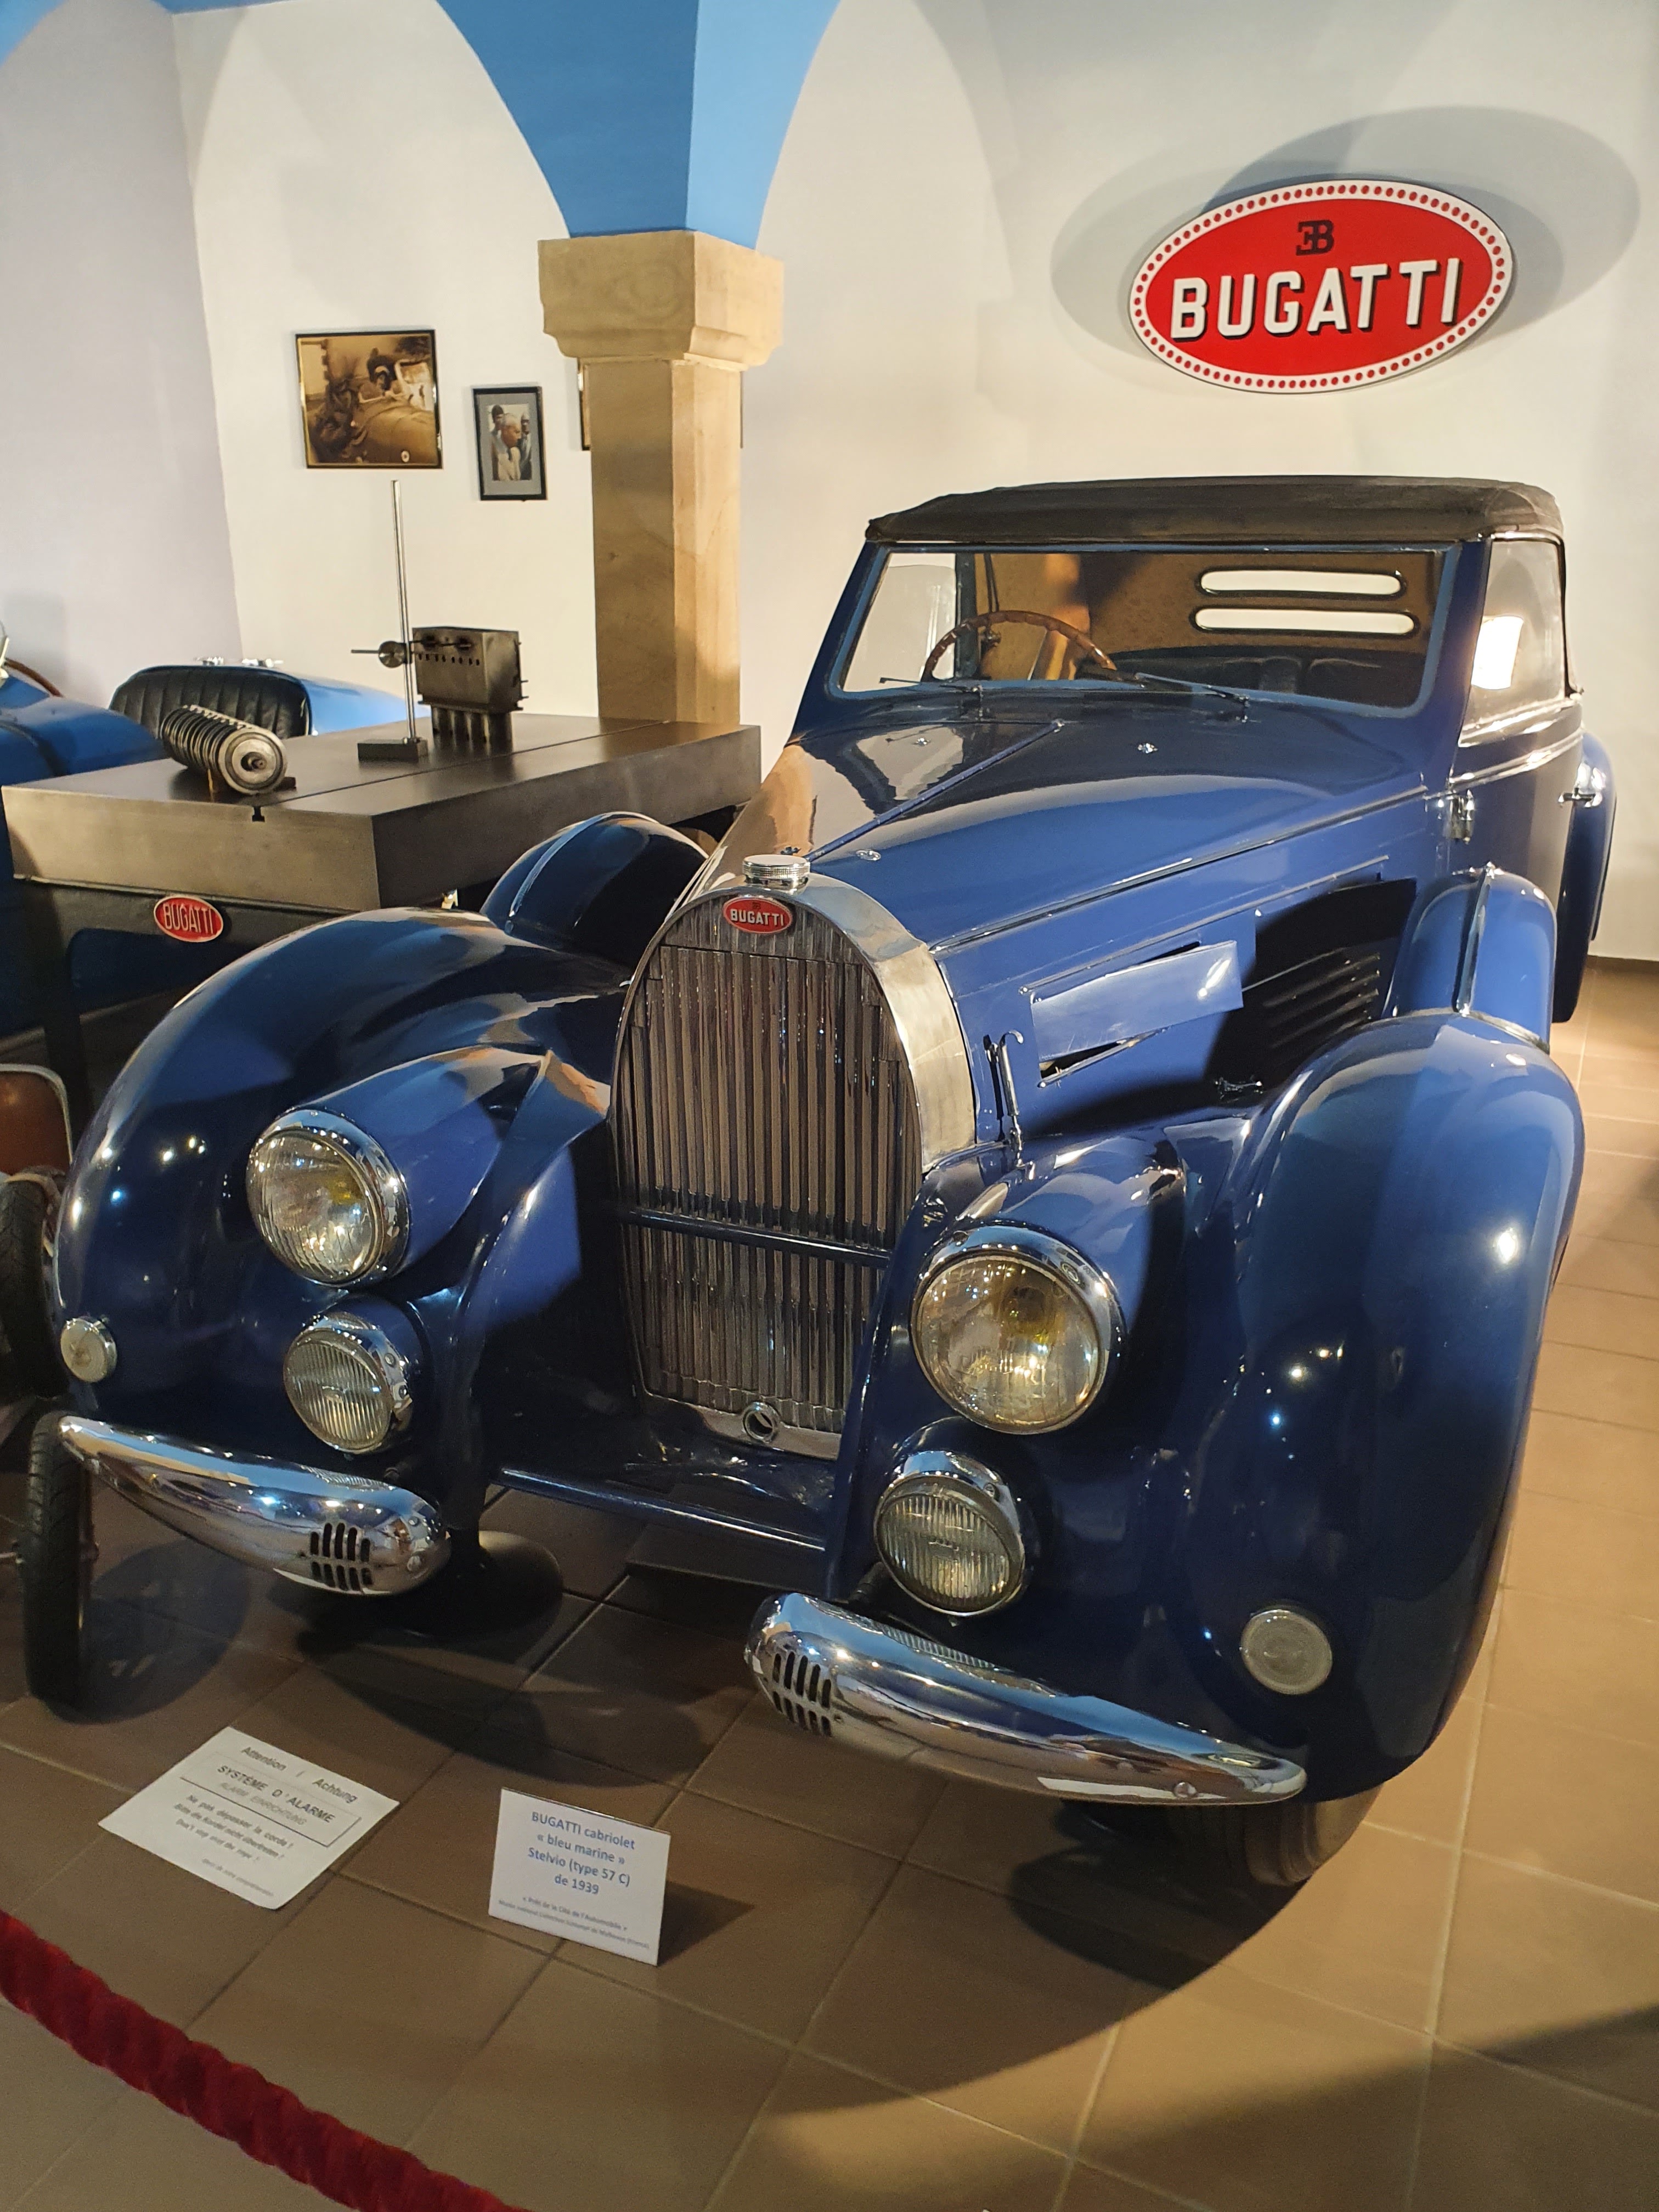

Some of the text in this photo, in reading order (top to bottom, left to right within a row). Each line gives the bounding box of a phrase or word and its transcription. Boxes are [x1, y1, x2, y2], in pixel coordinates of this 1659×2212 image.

[1170, 258, 1462, 340] BUGATTI
[163, 902, 213, 934] BUGATTI
[730, 908, 784, 926] BUGATTI
[241, 1747, 286, 1771] Attention
[312, 1779, 358, 1803] Achtung
[532, 1812, 635, 1849] BUGATTI cabriolet
[548, 1833, 571, 1850] bleu
[575, 1844, 614, 1862] marine
[528, 1847, 630, 1887] Stelvio (type 57 C)
[555, 1874, 599, 1894] de 1939
